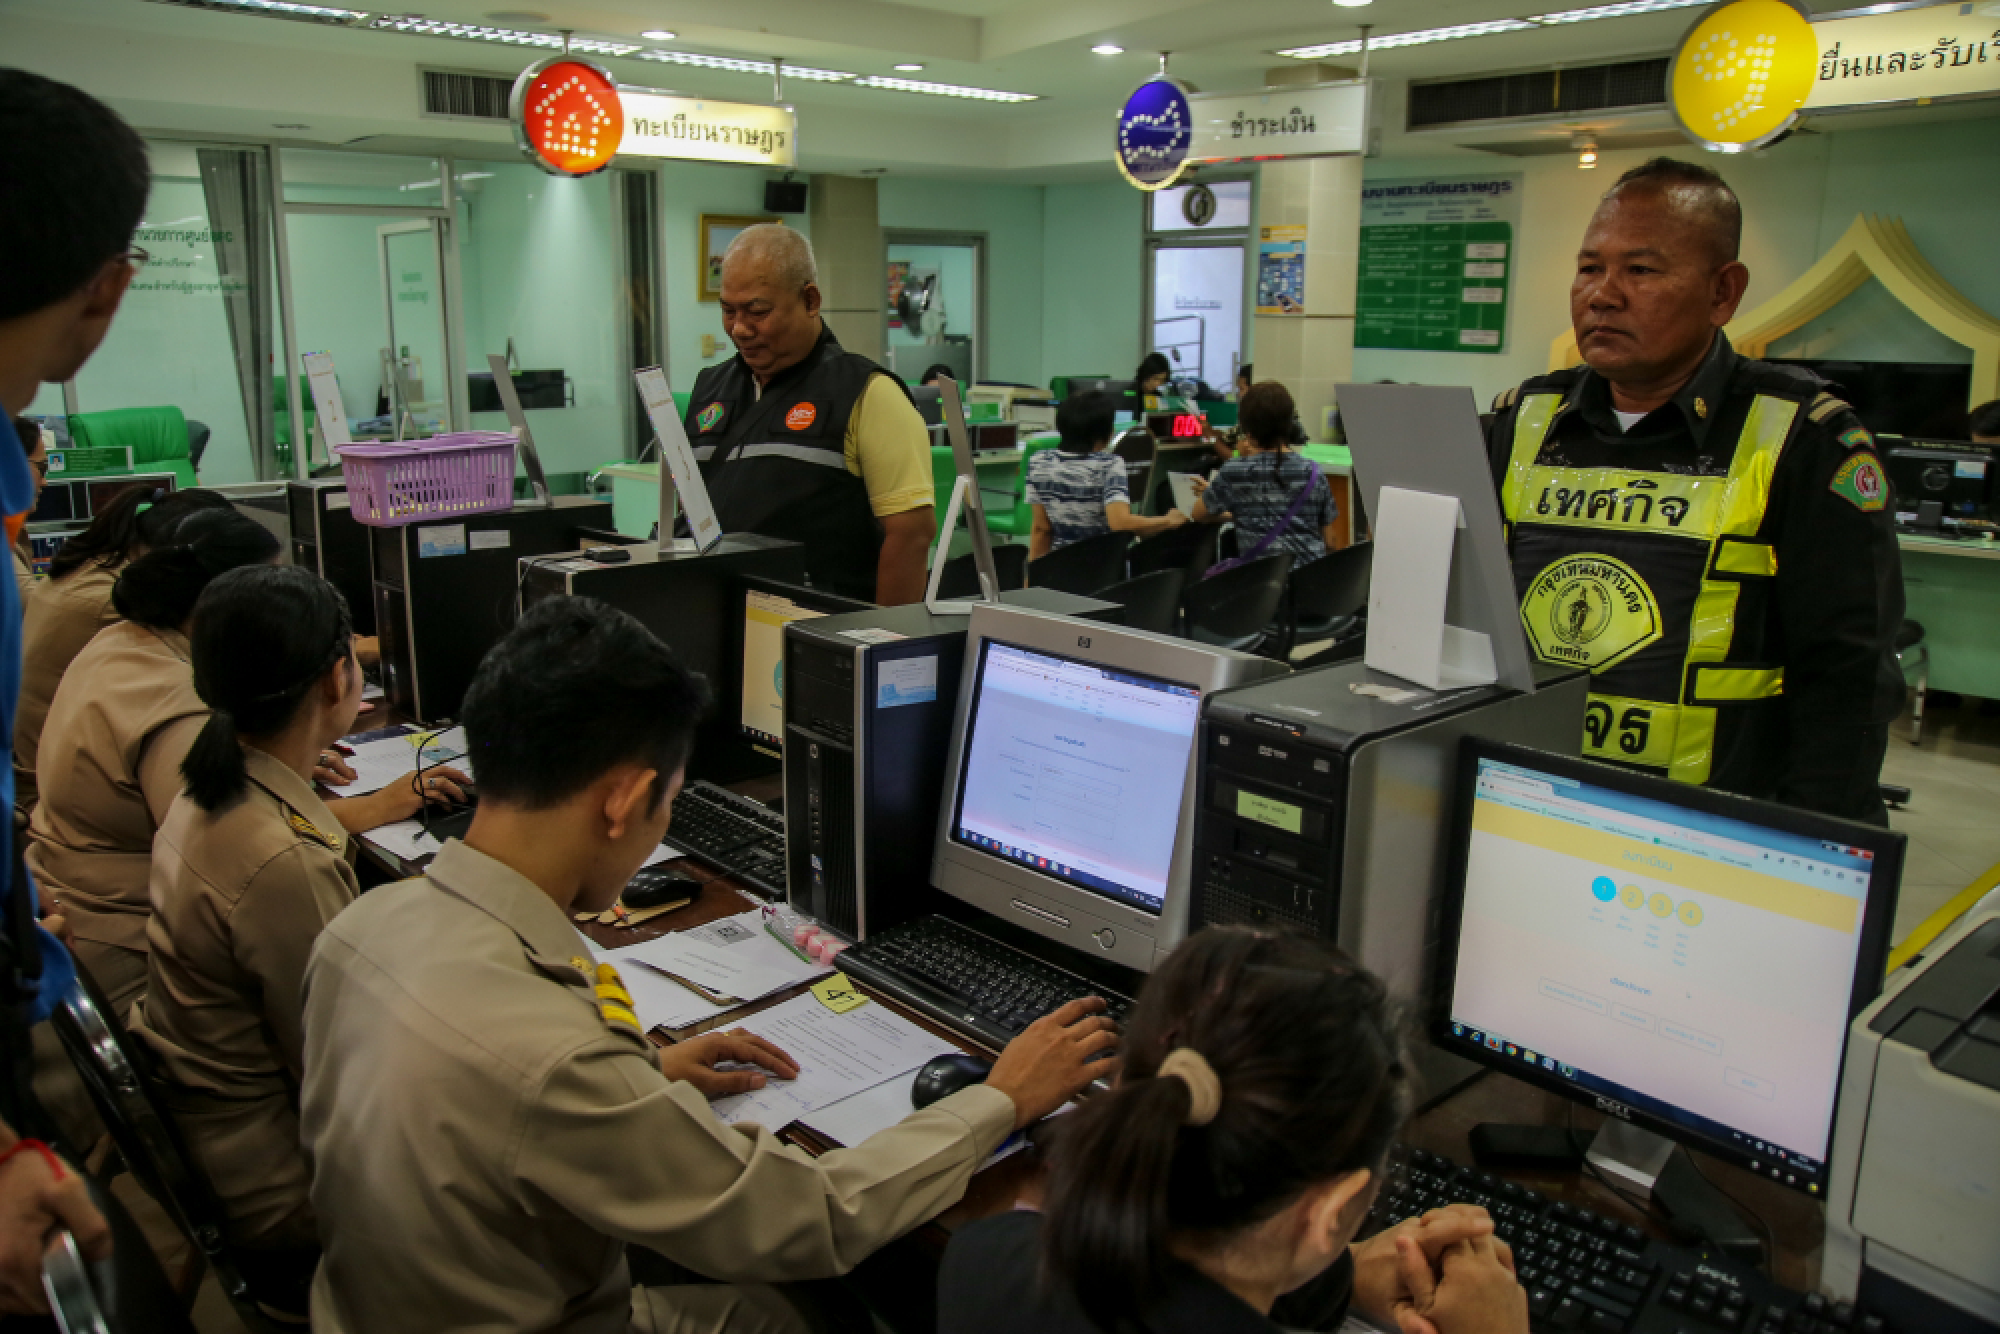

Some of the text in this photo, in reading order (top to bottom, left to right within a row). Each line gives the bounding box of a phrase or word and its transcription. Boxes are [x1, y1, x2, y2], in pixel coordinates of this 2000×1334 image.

[631, 112, 787, 155] ทะเบียนราษฎร
[1230, 106, 1317, 139] ชำระเงิน
[1536, 479, 1691, 527] เทศกิจ
